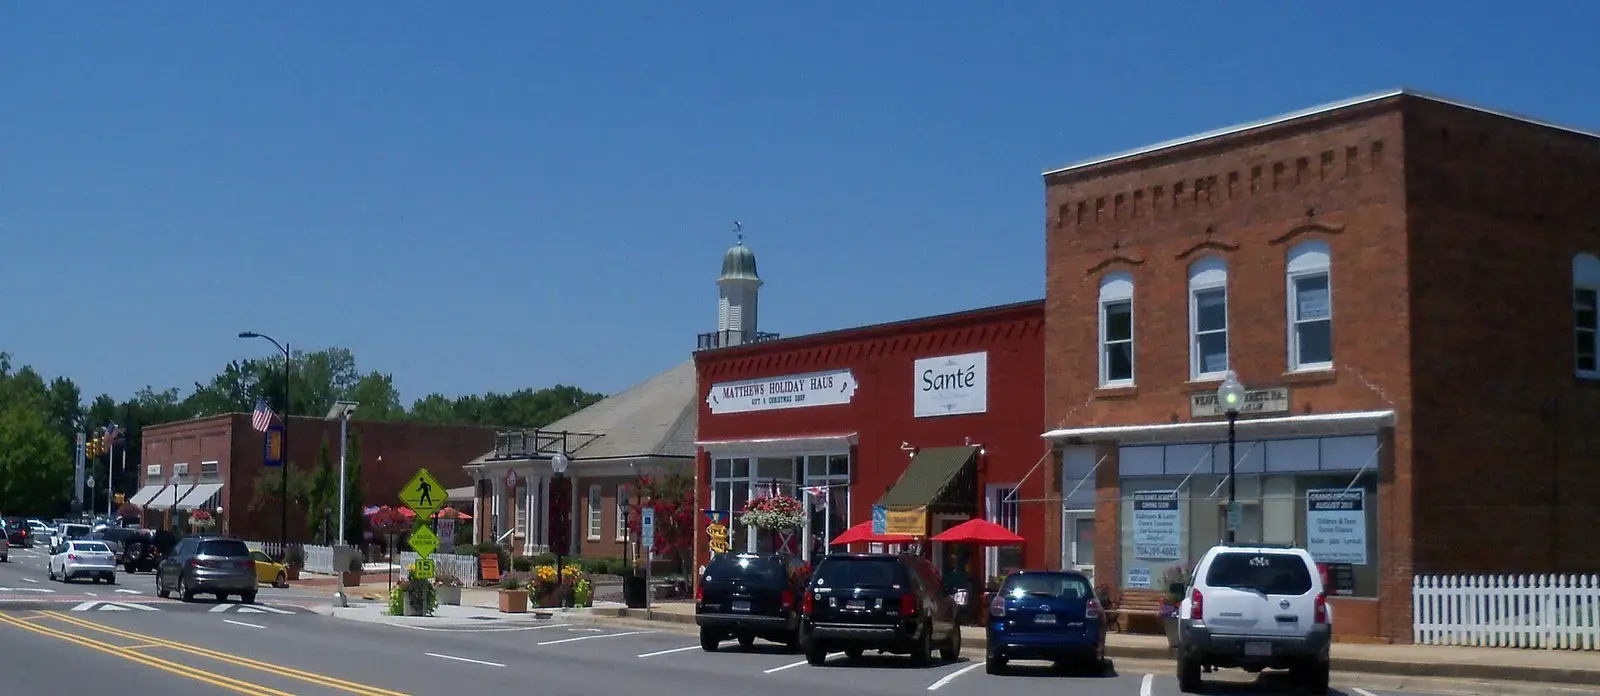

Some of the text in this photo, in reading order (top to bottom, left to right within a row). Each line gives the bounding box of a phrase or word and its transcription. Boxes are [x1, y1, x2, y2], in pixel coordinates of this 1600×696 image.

[922, 364, 975, 391] Santé
[723, 377, 834, 399] MATTHEWS HOLIDAY HAUS
[769, 395, 792, 404] CHRISTMAS
[1315, 501, 1339, 509] AUGUST
[418, 561, 431, 571] 15
